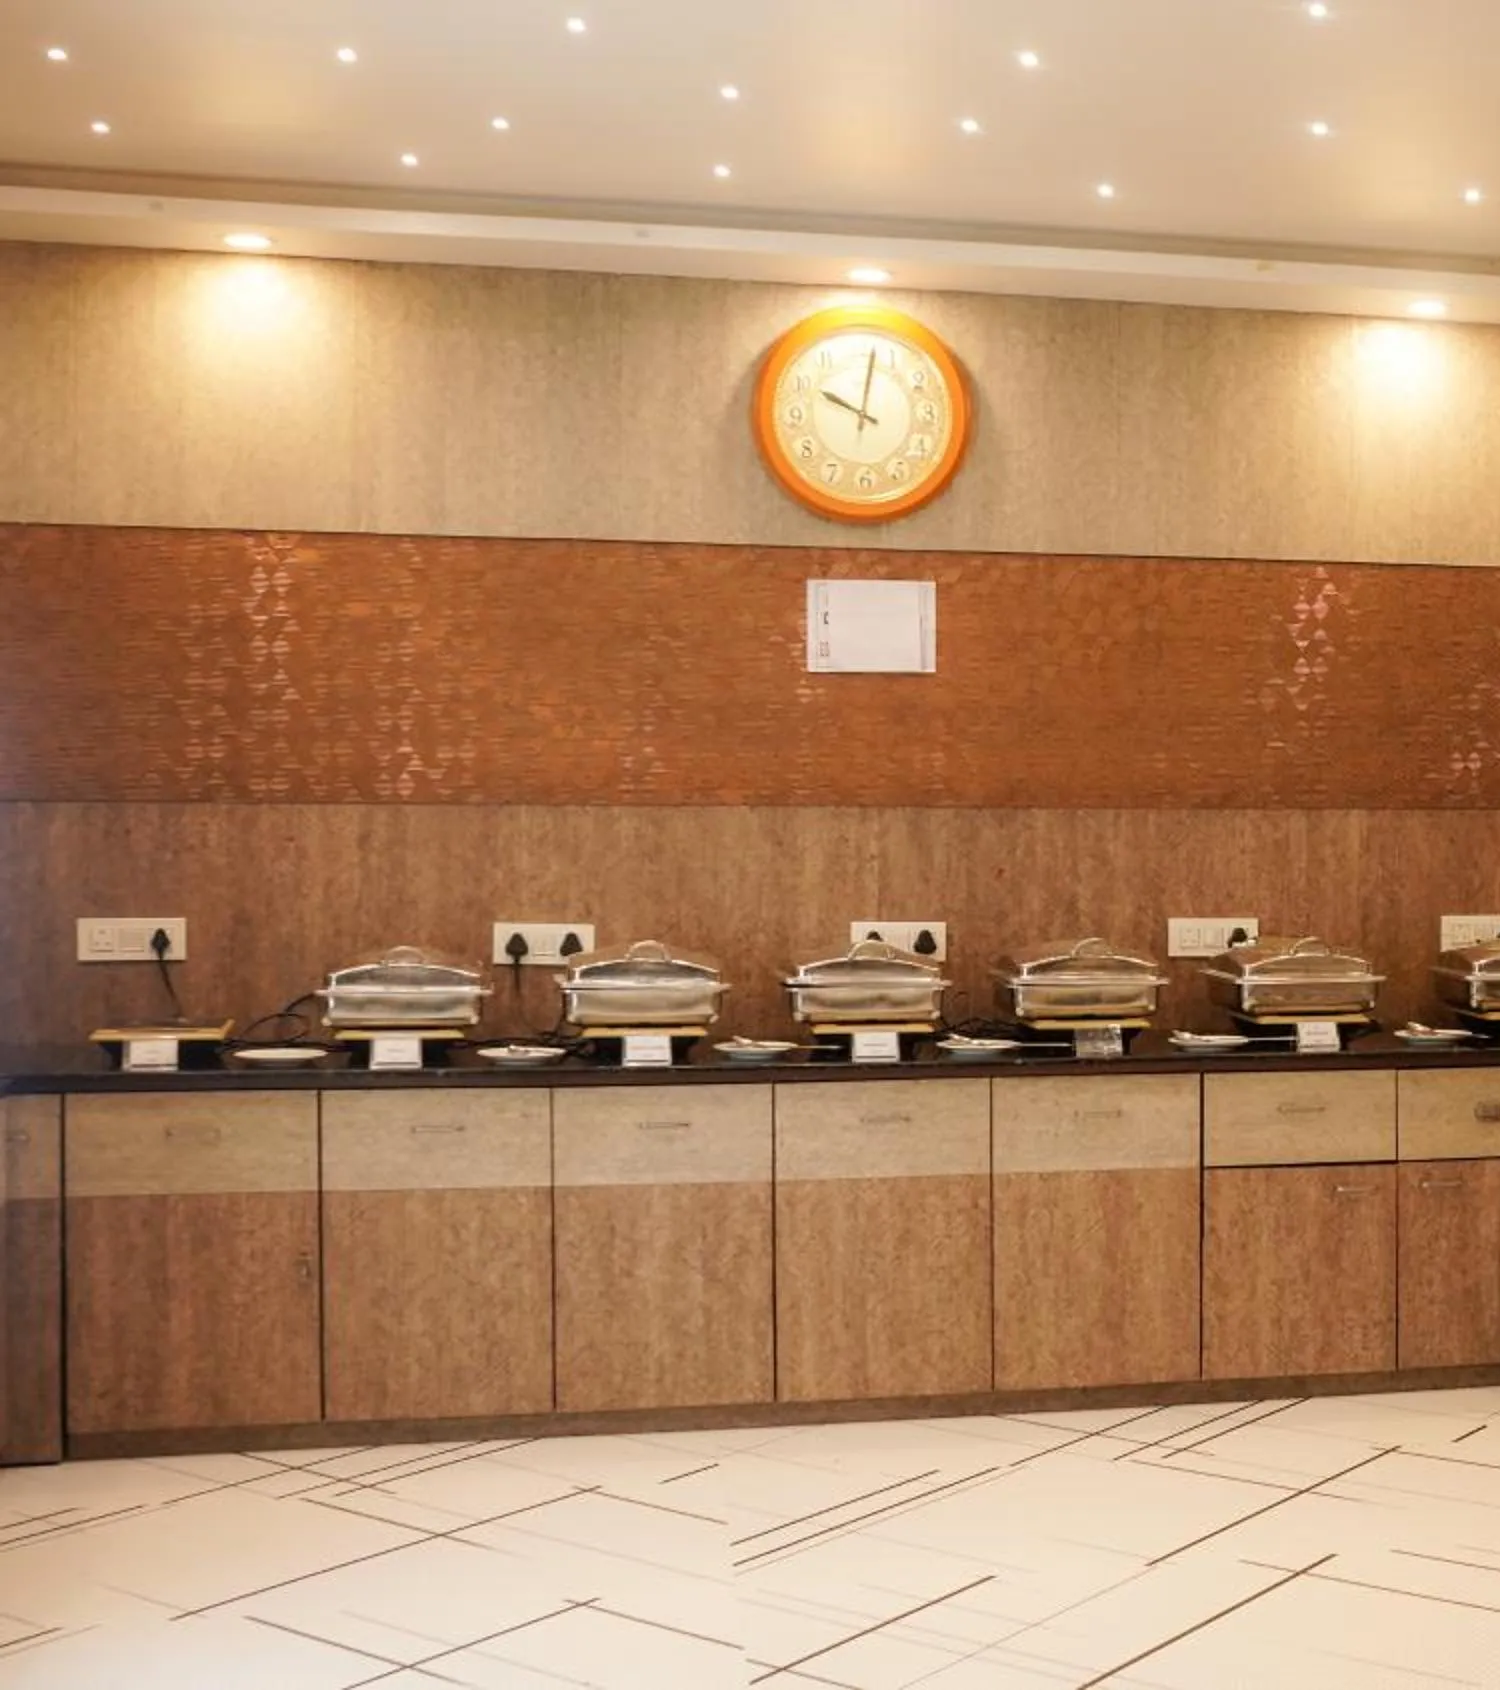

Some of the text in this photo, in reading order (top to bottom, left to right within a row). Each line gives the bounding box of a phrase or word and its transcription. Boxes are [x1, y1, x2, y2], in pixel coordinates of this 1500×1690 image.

[800, 438, 814, 459] 8
[826, 462, 838, 483] 7
[858, 469, 873, 489] 6
